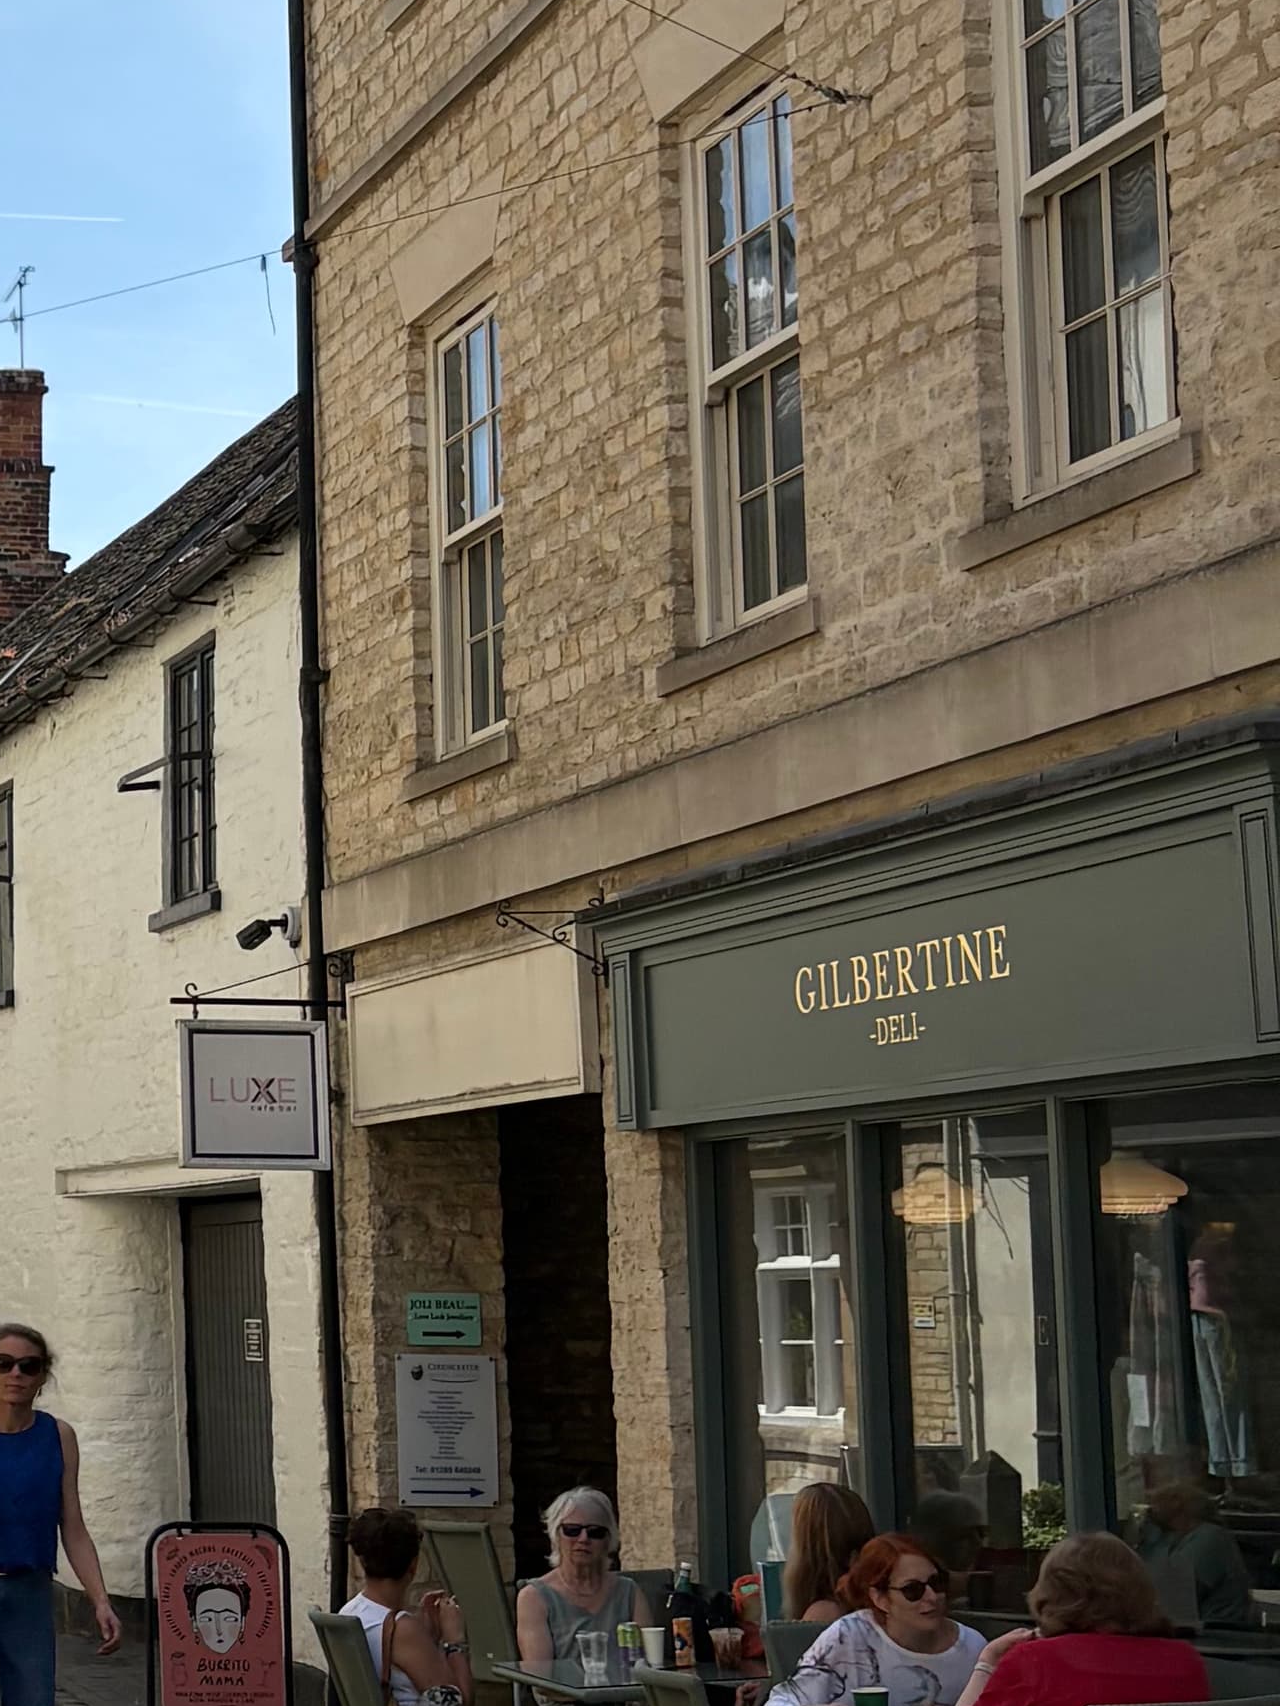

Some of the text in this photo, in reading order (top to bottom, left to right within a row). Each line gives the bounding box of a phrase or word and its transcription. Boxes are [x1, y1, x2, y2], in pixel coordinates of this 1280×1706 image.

[794, 924, 1011, 1014] GILBERTINE
[210, 1077, 297, 1104] LUXE
[197, 1657, 251, 1673] BURRITO
